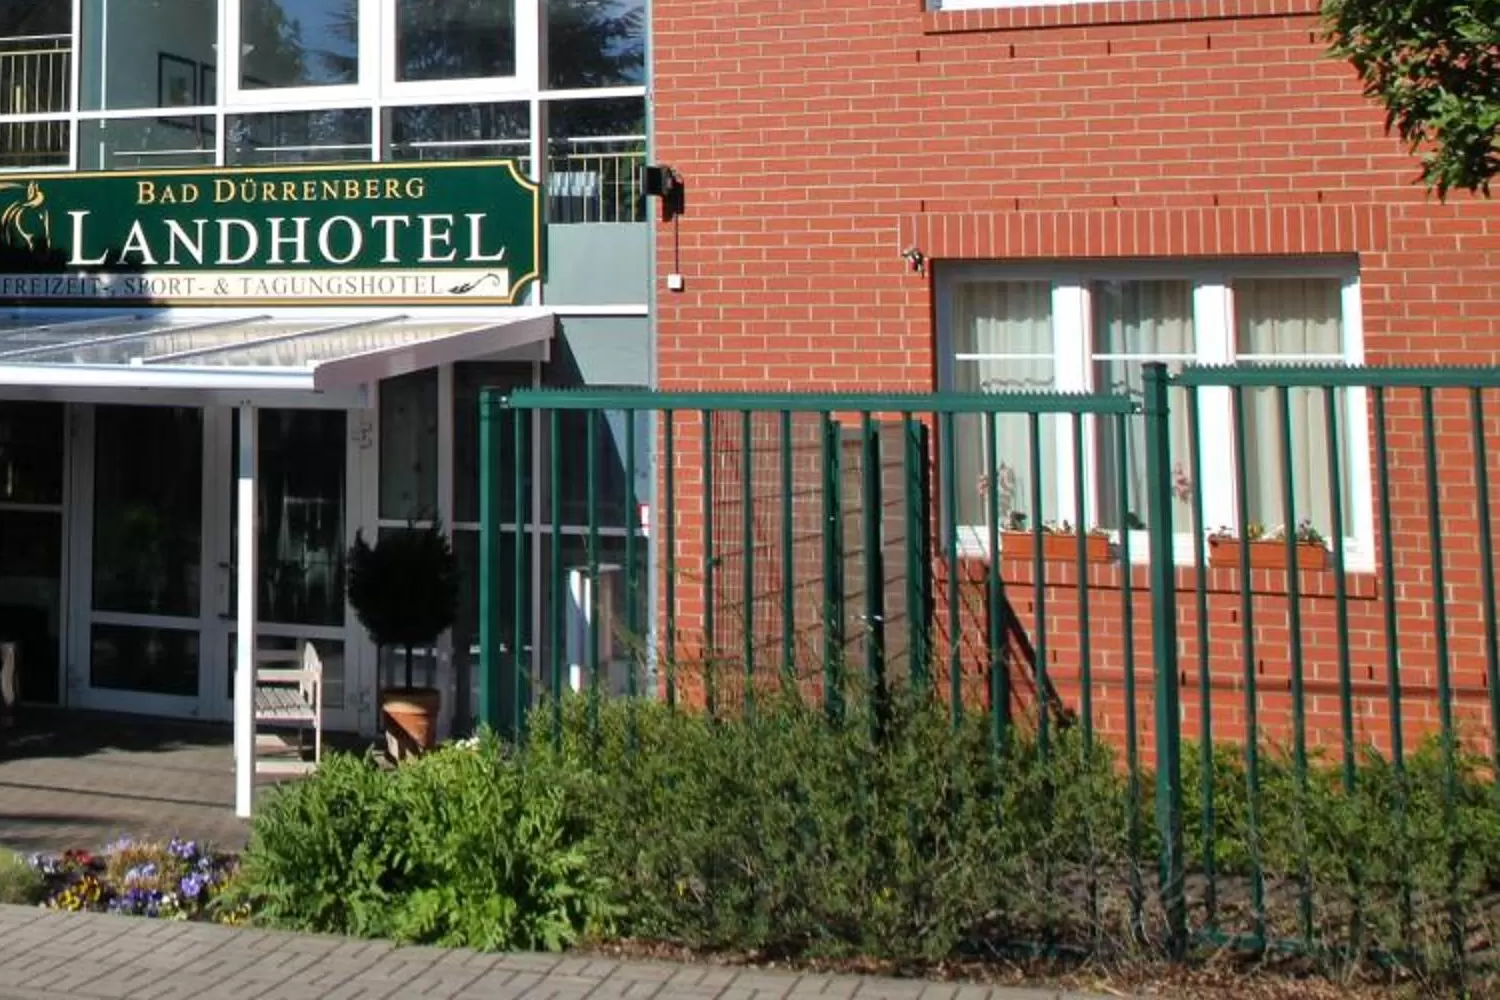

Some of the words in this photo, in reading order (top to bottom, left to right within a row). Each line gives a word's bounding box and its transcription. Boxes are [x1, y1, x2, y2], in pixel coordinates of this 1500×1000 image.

[137, 180, 199, 204] BAD
[214, 177, 426, 203] DÜRRENBERG
[67, 210, 507, 266] LANDHOTEL
[123, 275, 205, 295] SPORT-
[214, 275, 231, 295] &
[239, 275, 444, 295] TAGUNGSHOTEL
